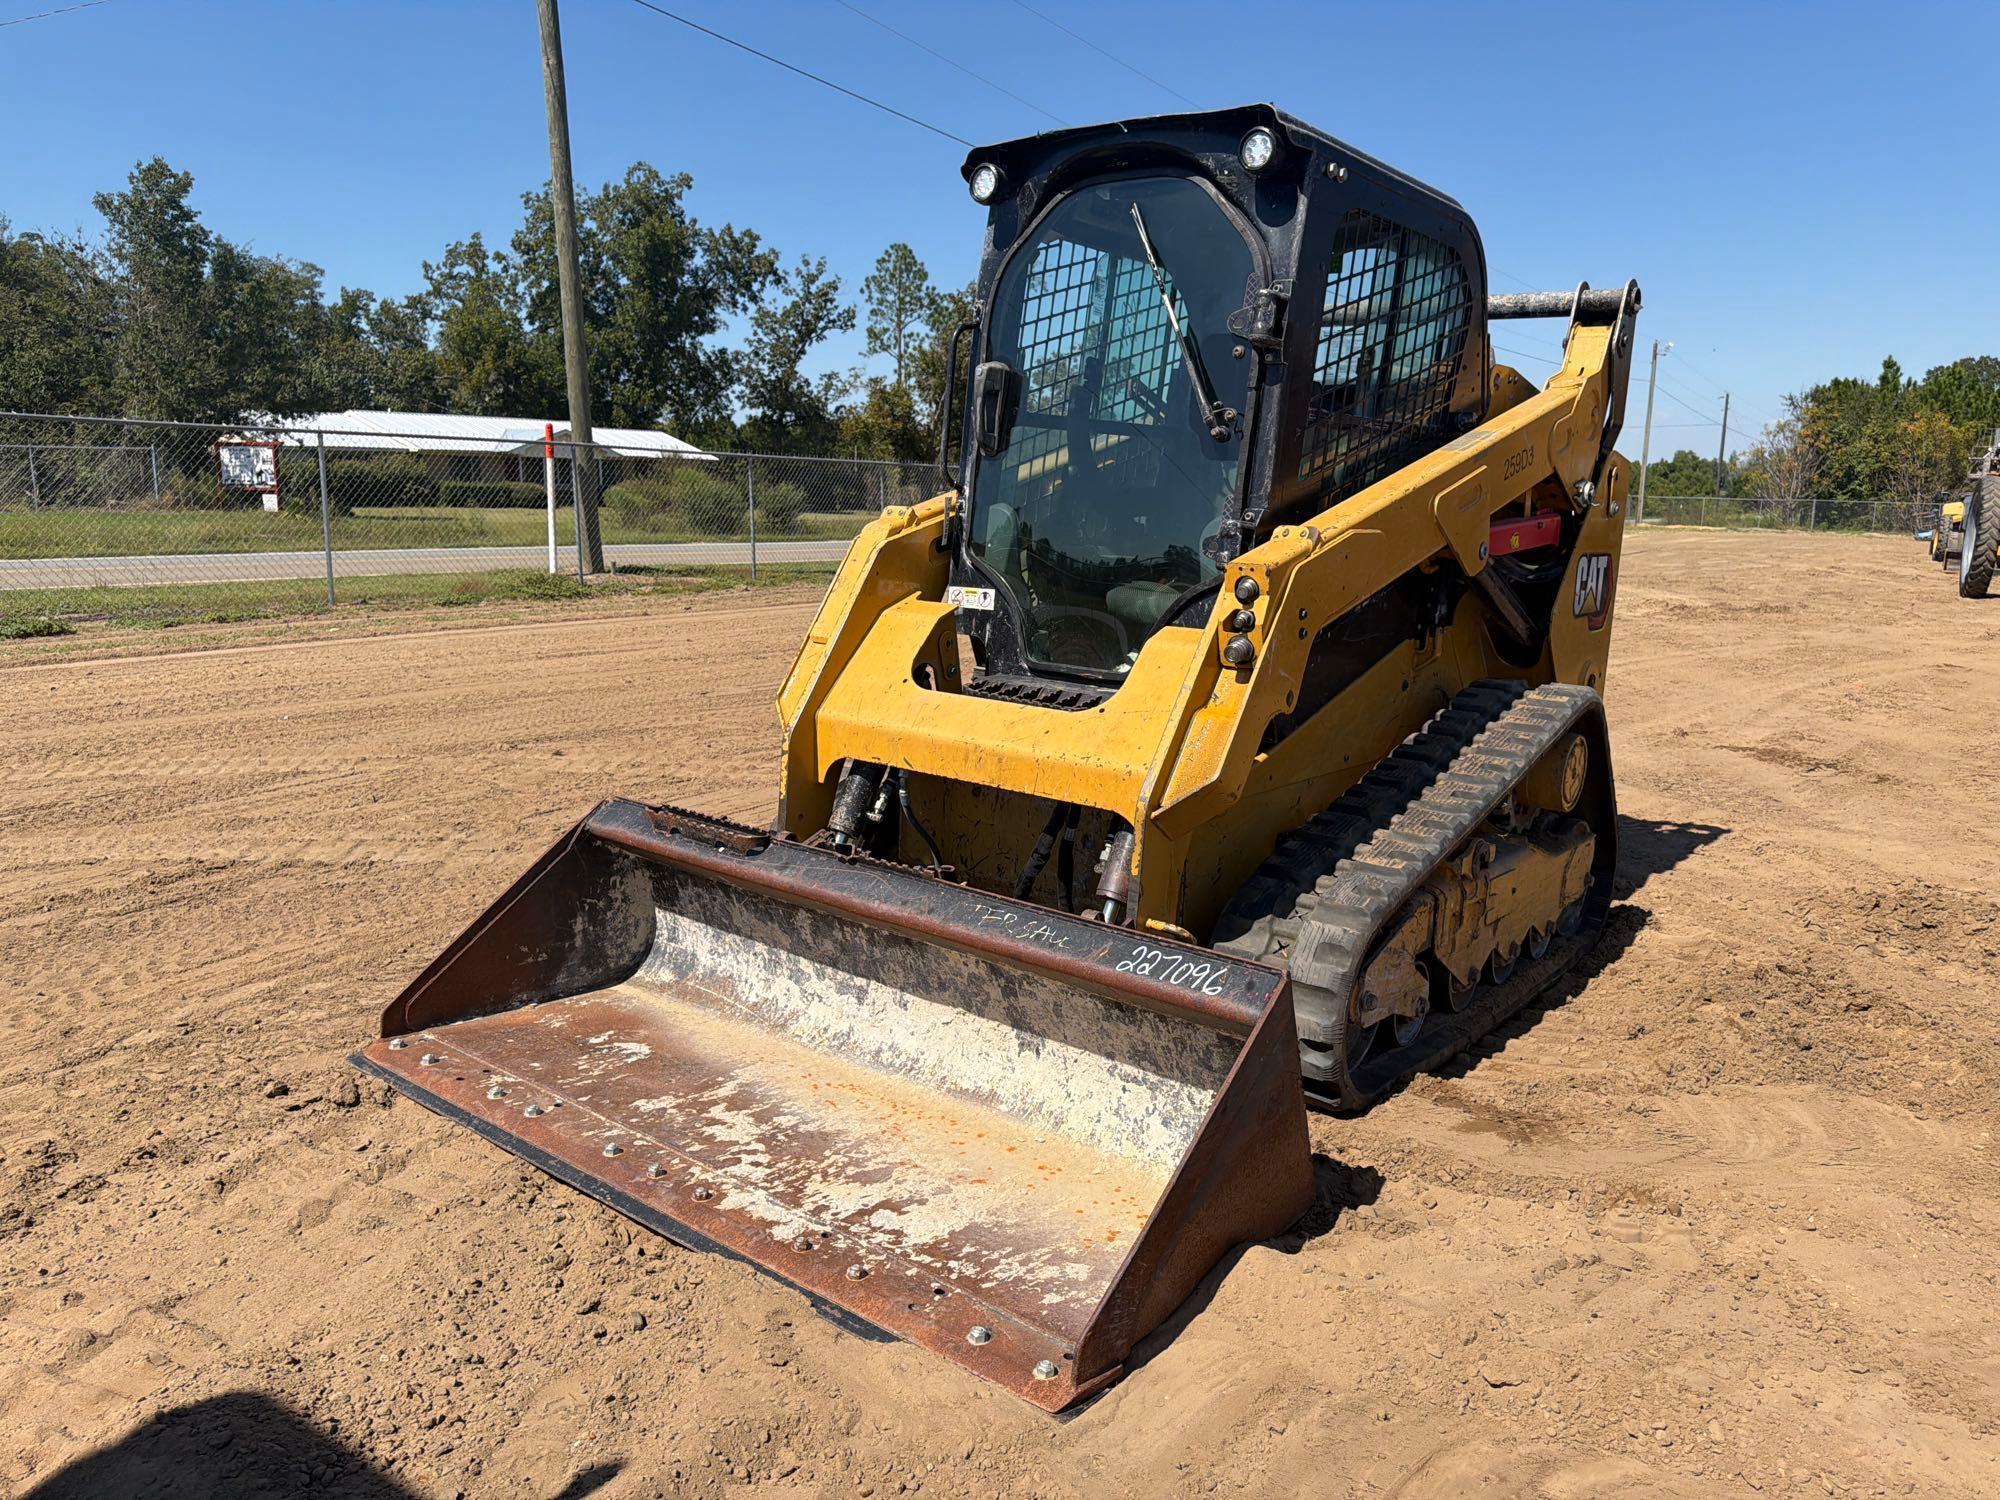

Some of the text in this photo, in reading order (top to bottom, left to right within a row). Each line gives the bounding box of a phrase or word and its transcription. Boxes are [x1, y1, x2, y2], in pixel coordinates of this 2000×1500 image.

[1504, 446, 1534, 481] 259D3
[1574, 556, 1608, 615] CAT
[1116, 946, 1228, 995] 227096
